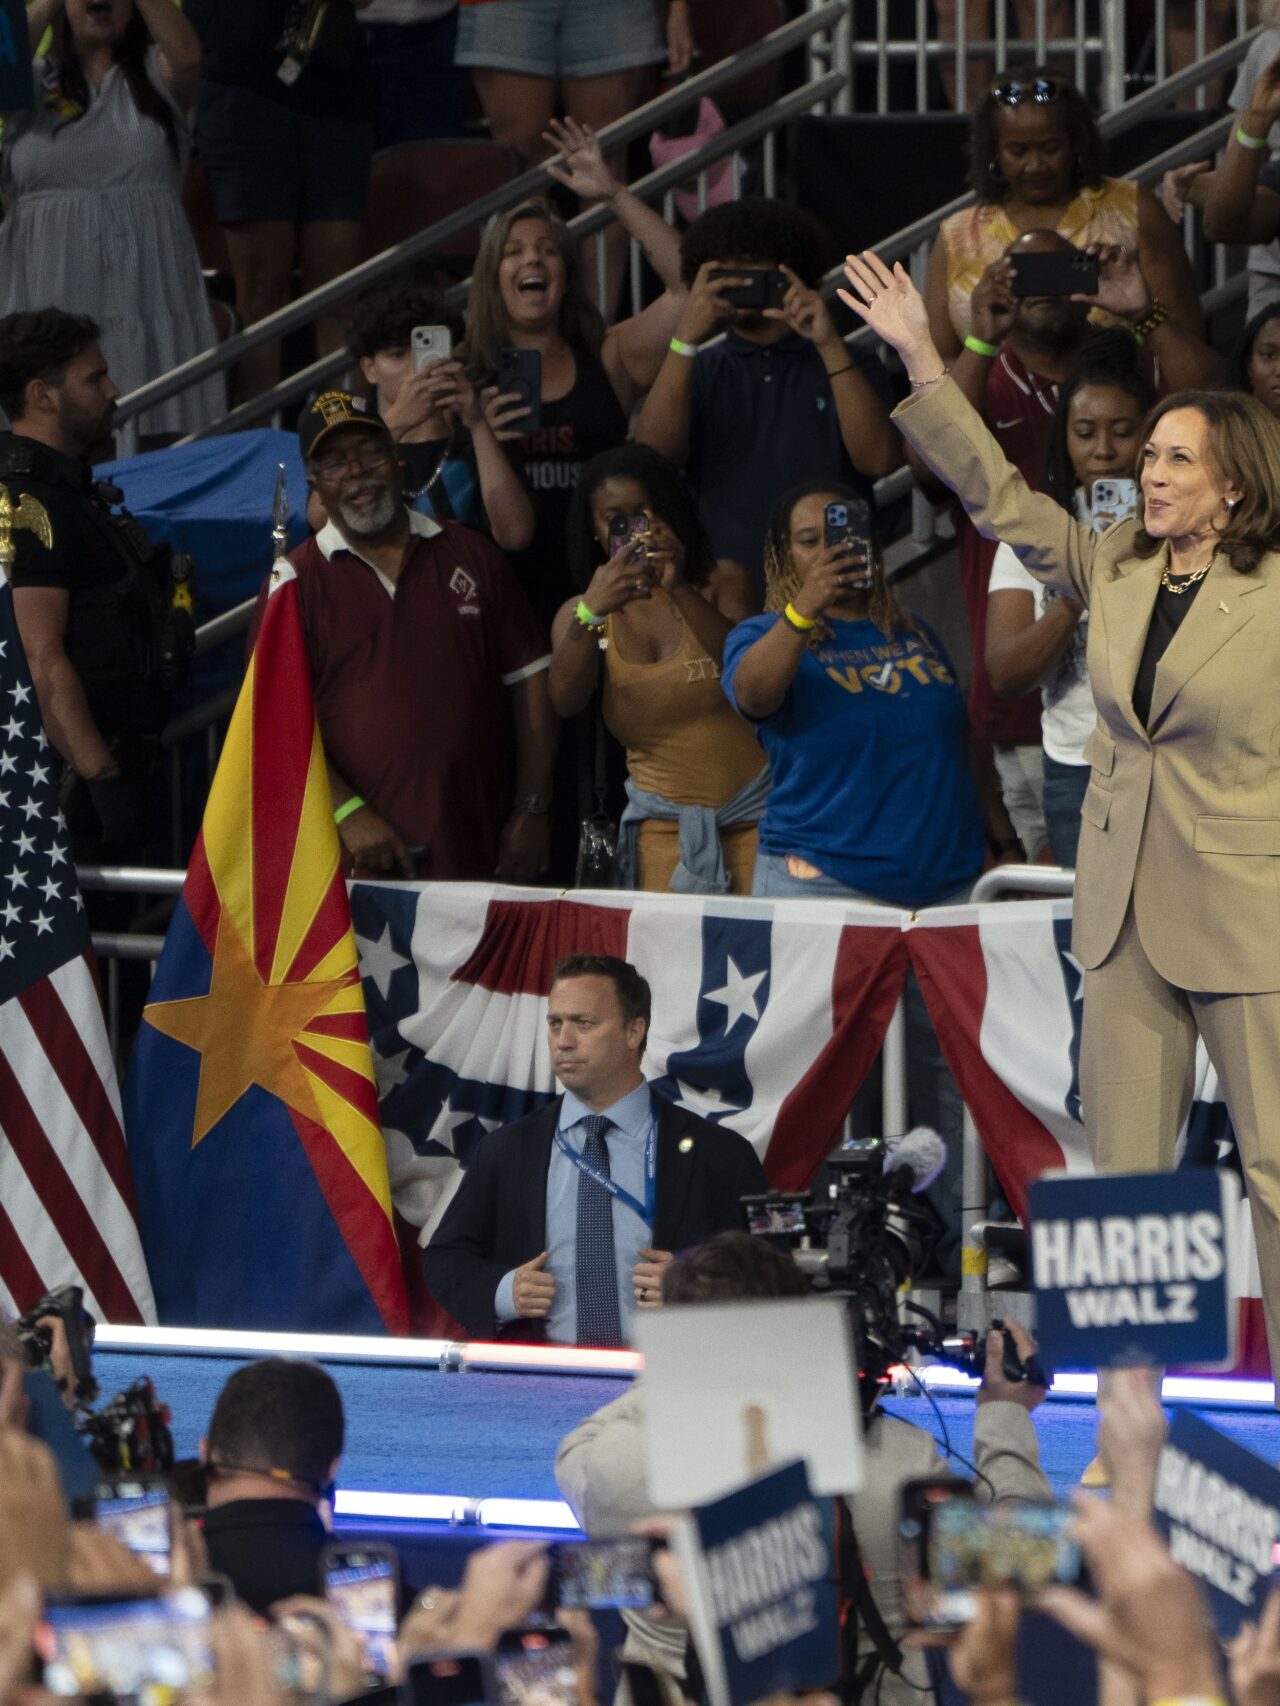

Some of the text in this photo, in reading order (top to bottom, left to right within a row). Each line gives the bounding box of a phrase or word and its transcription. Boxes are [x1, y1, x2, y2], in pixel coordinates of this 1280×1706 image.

[1031, 1212, 1223, 1290] HARRIS
[1065, 1284, 1198, 1329] WALZ
[1155, 1445, 1280, 1576] HARRIS
[702, 1503, 828, 1622] HARRIS
[1169, 1520, 1265, 1606] WALZ
[730, 1586, 820, 1663] WALZ
